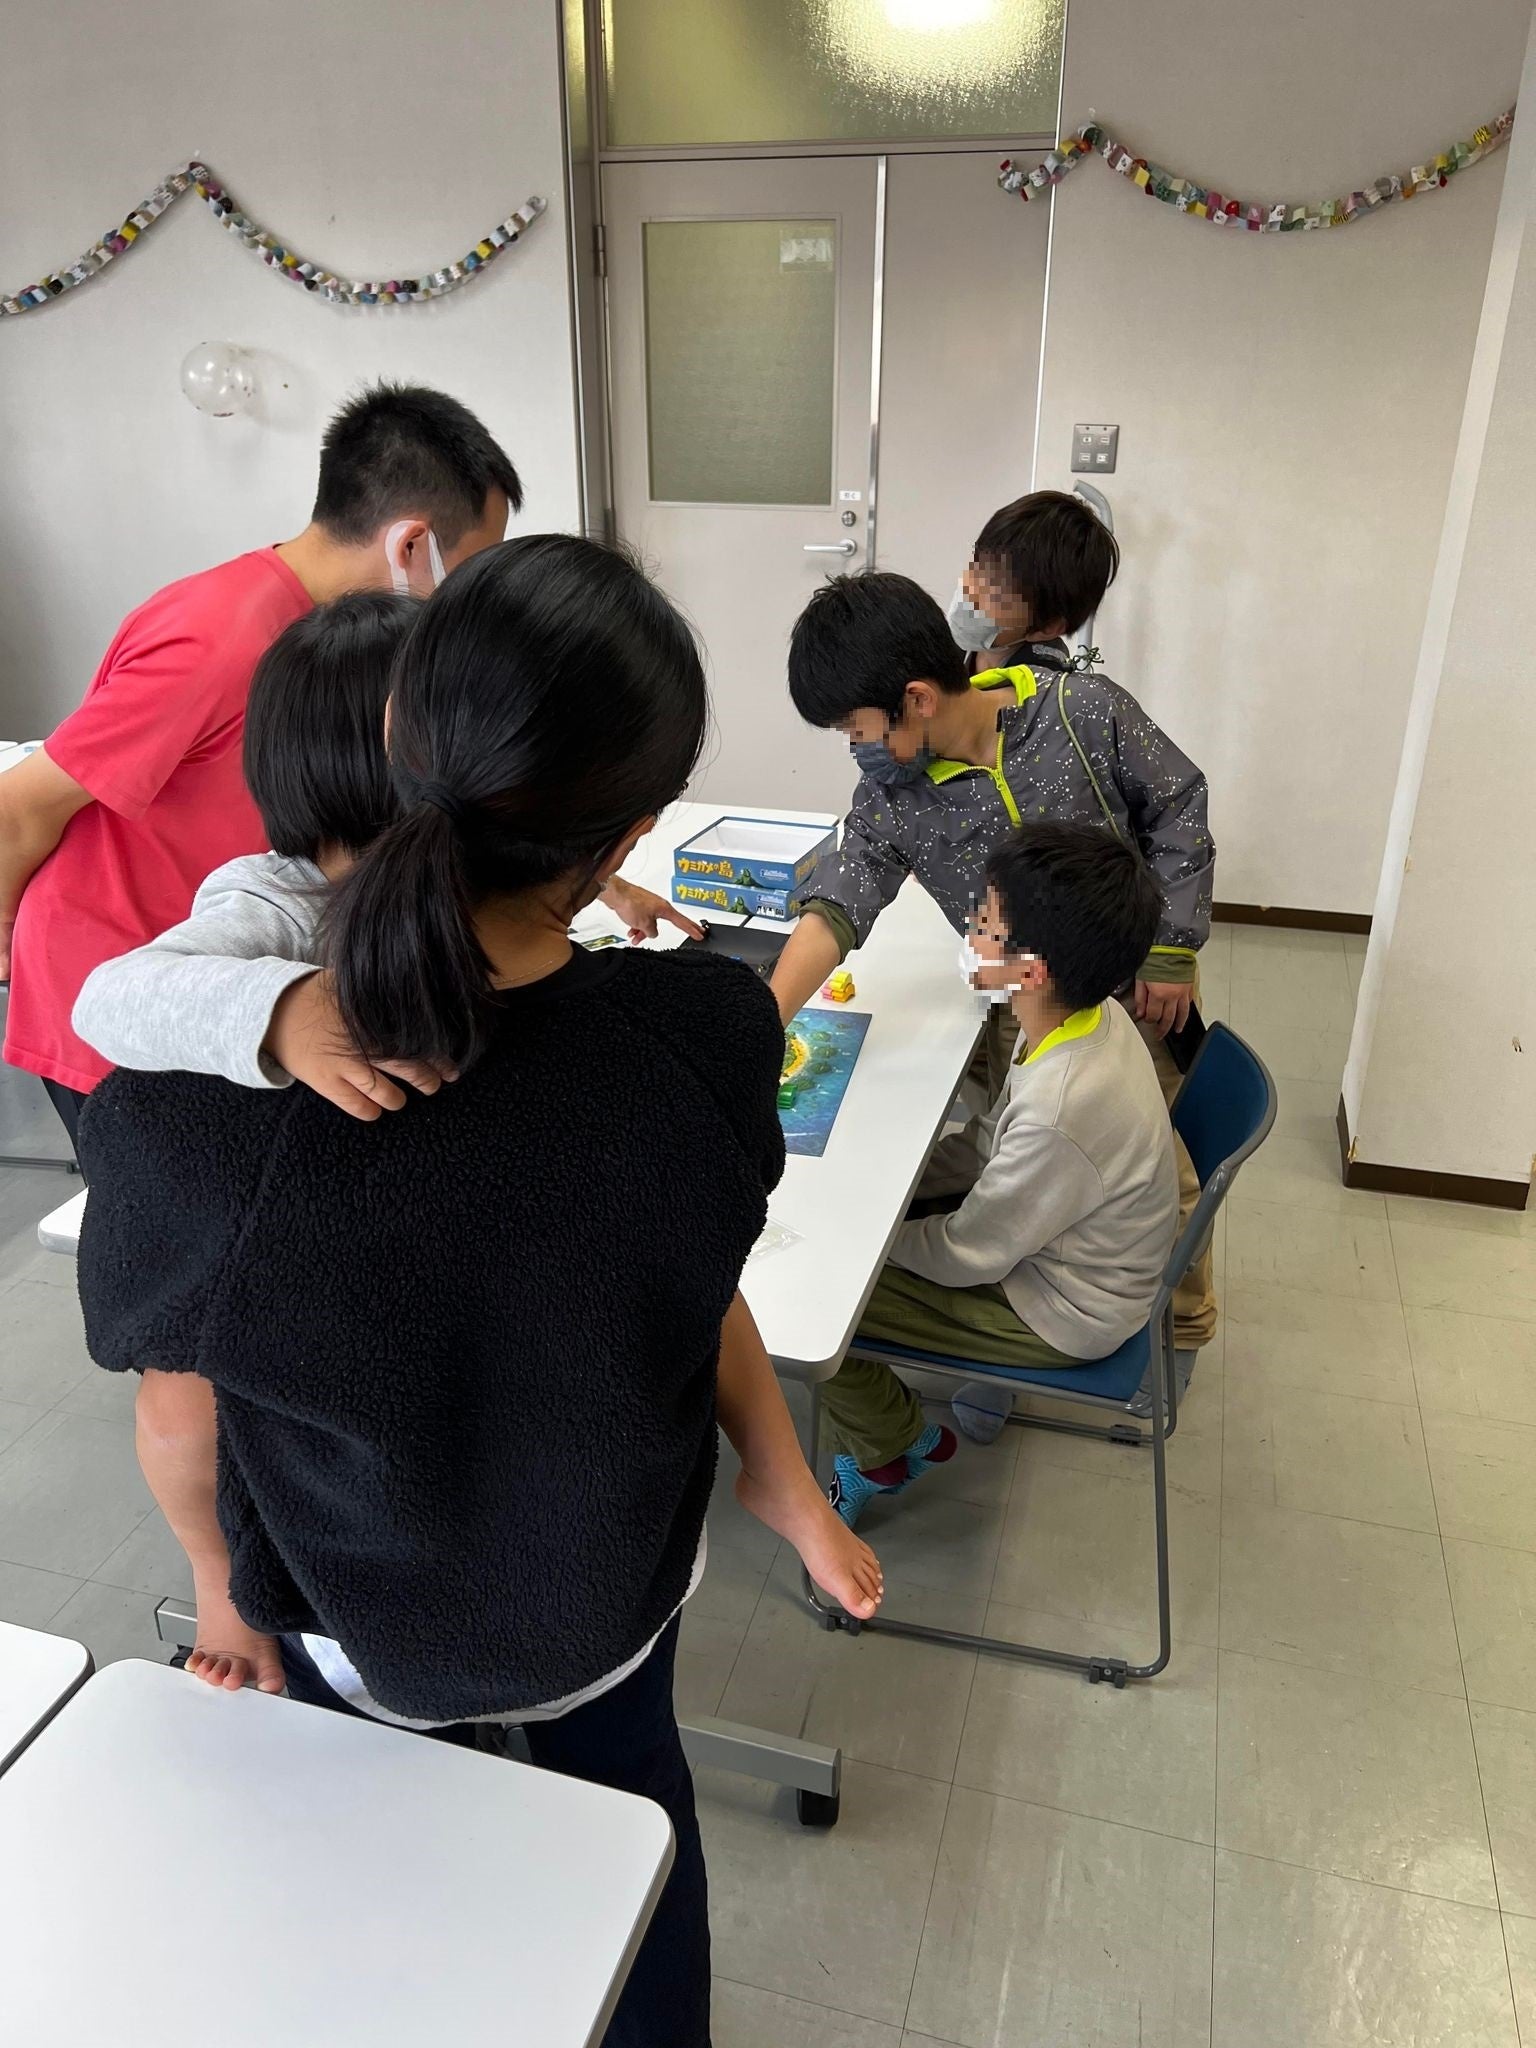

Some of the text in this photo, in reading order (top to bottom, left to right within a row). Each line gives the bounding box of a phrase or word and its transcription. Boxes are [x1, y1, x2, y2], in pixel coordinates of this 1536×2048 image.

[677, 857, 734, 878] ウミガメの島
[675, 884, 729, 907] ウミガメの島
